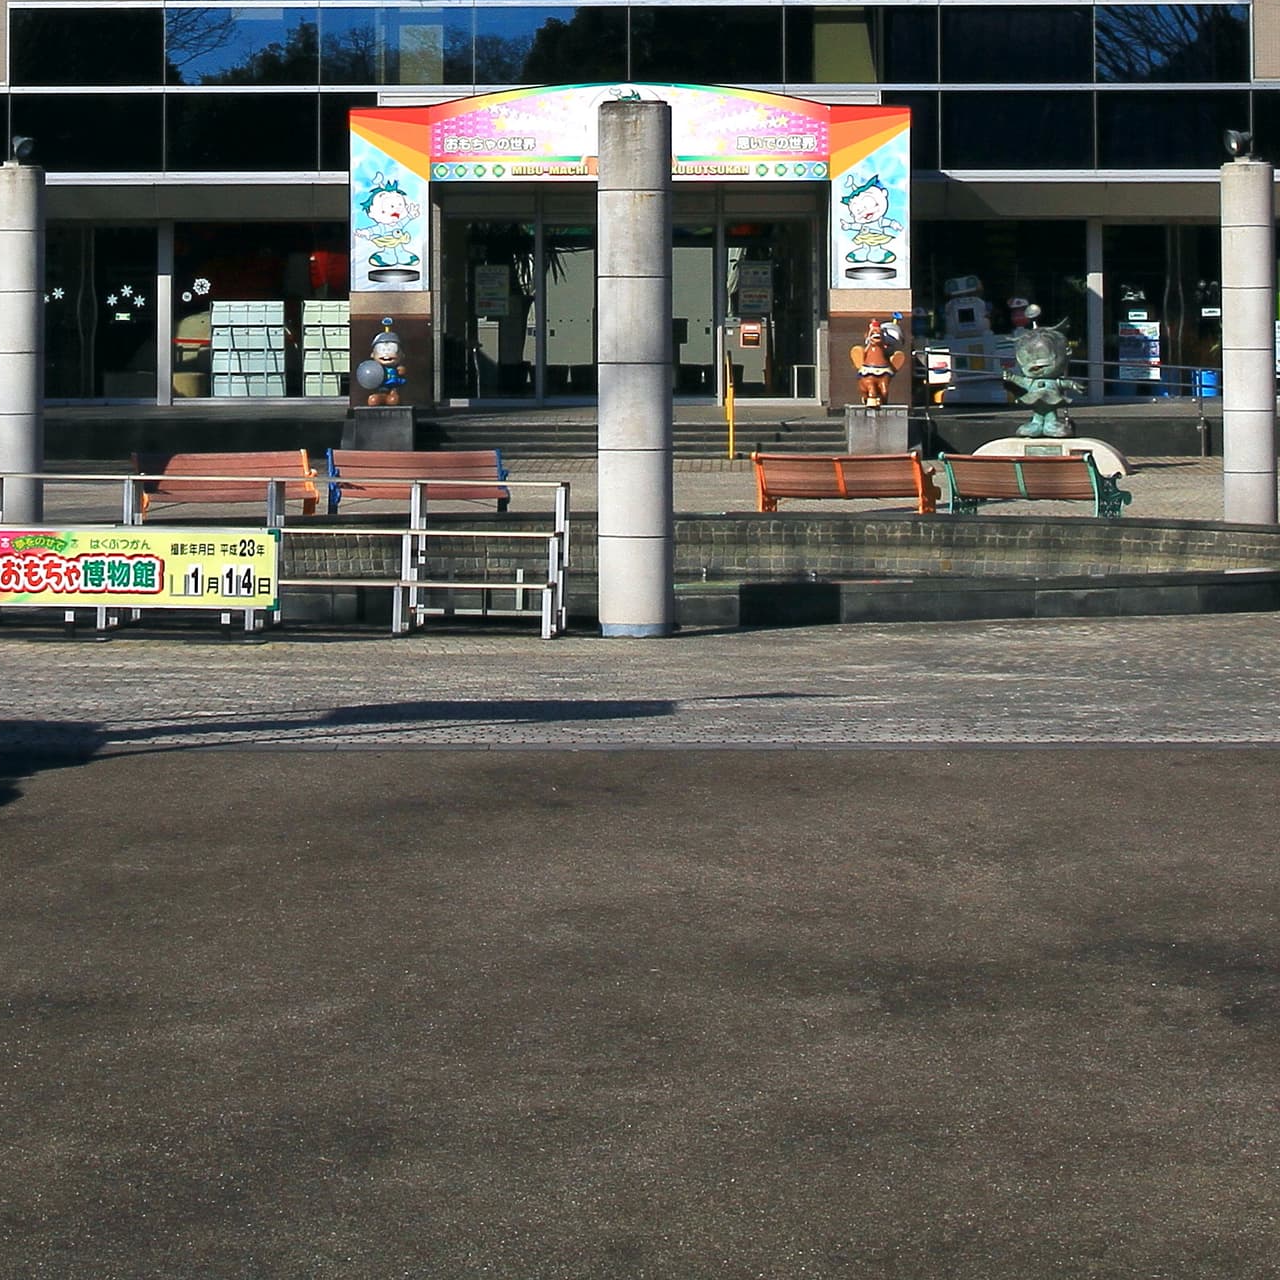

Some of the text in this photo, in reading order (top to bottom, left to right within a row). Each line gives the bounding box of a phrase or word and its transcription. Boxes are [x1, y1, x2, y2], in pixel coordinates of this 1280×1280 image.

[445, 136, 537, 152] おもちゃの世界
[736, 135, 817, 151] 思いでの世界
[511, 164, 589, 176] MIBU-MACHI
[89, 539, 151, 550] はくぶつかん
